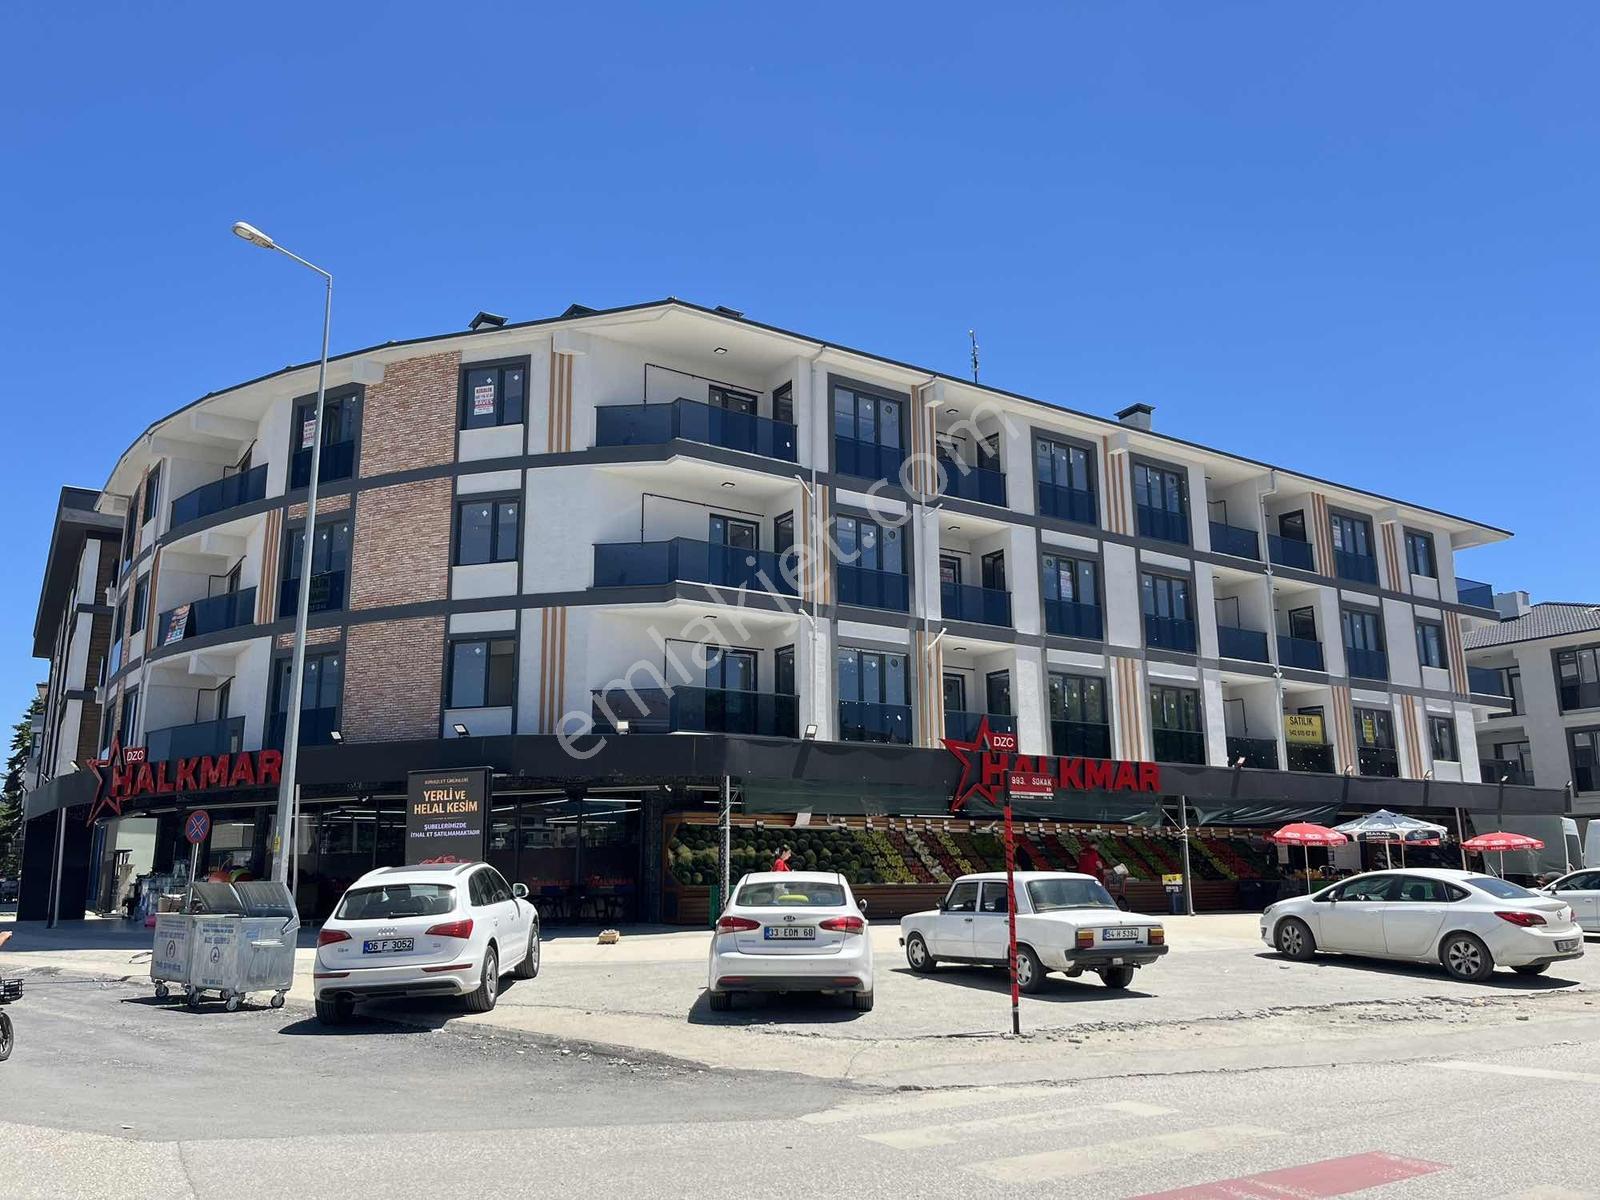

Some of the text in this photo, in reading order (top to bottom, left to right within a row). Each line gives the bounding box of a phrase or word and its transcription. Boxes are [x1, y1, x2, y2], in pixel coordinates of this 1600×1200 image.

[1289, 716, 1314, 726] SATILIK
[993, 736, 1015, 749] DZC
[127, 750, 144, 762] DZC
[111, 749, 282, 797] HALKMAR
[1031, 777, 1052, 786] SOKAK
[423, 787, 466, 802] YERLİ VE
[413, 800, 478, 815] HELAL KESİM
[769, 928, 779, 937] 33
[368, 940, 412, 951] 06 F 3052
